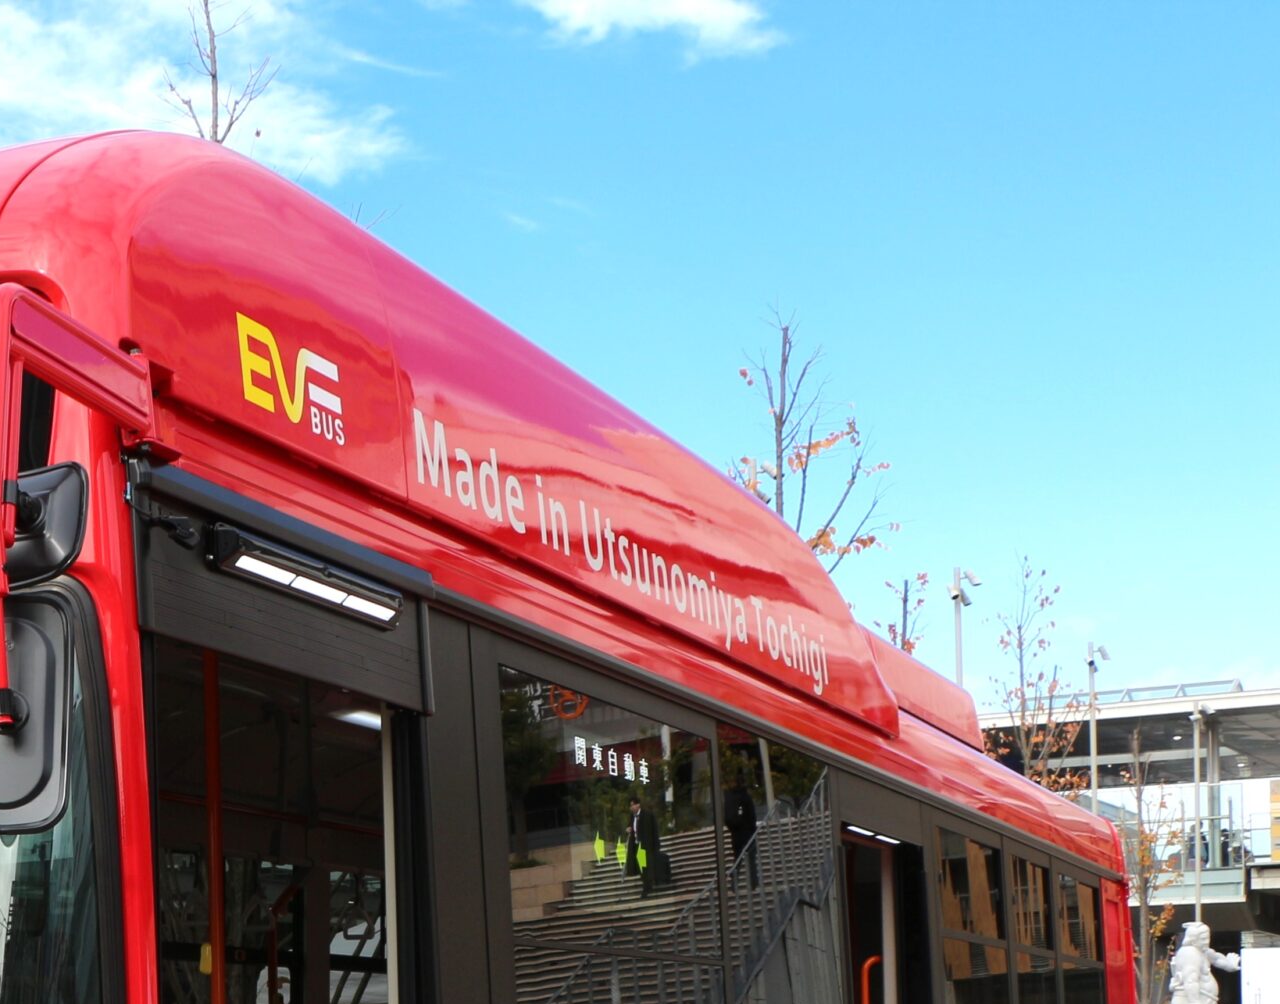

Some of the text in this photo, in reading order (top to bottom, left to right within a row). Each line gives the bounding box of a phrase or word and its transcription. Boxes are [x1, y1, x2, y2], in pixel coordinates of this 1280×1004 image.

[310, 405, 345, 446] BUS
[413, 407, 829, 695] Made in Utsunomiya Tochigi
[574, 735, 651, 785] 関東自動車
